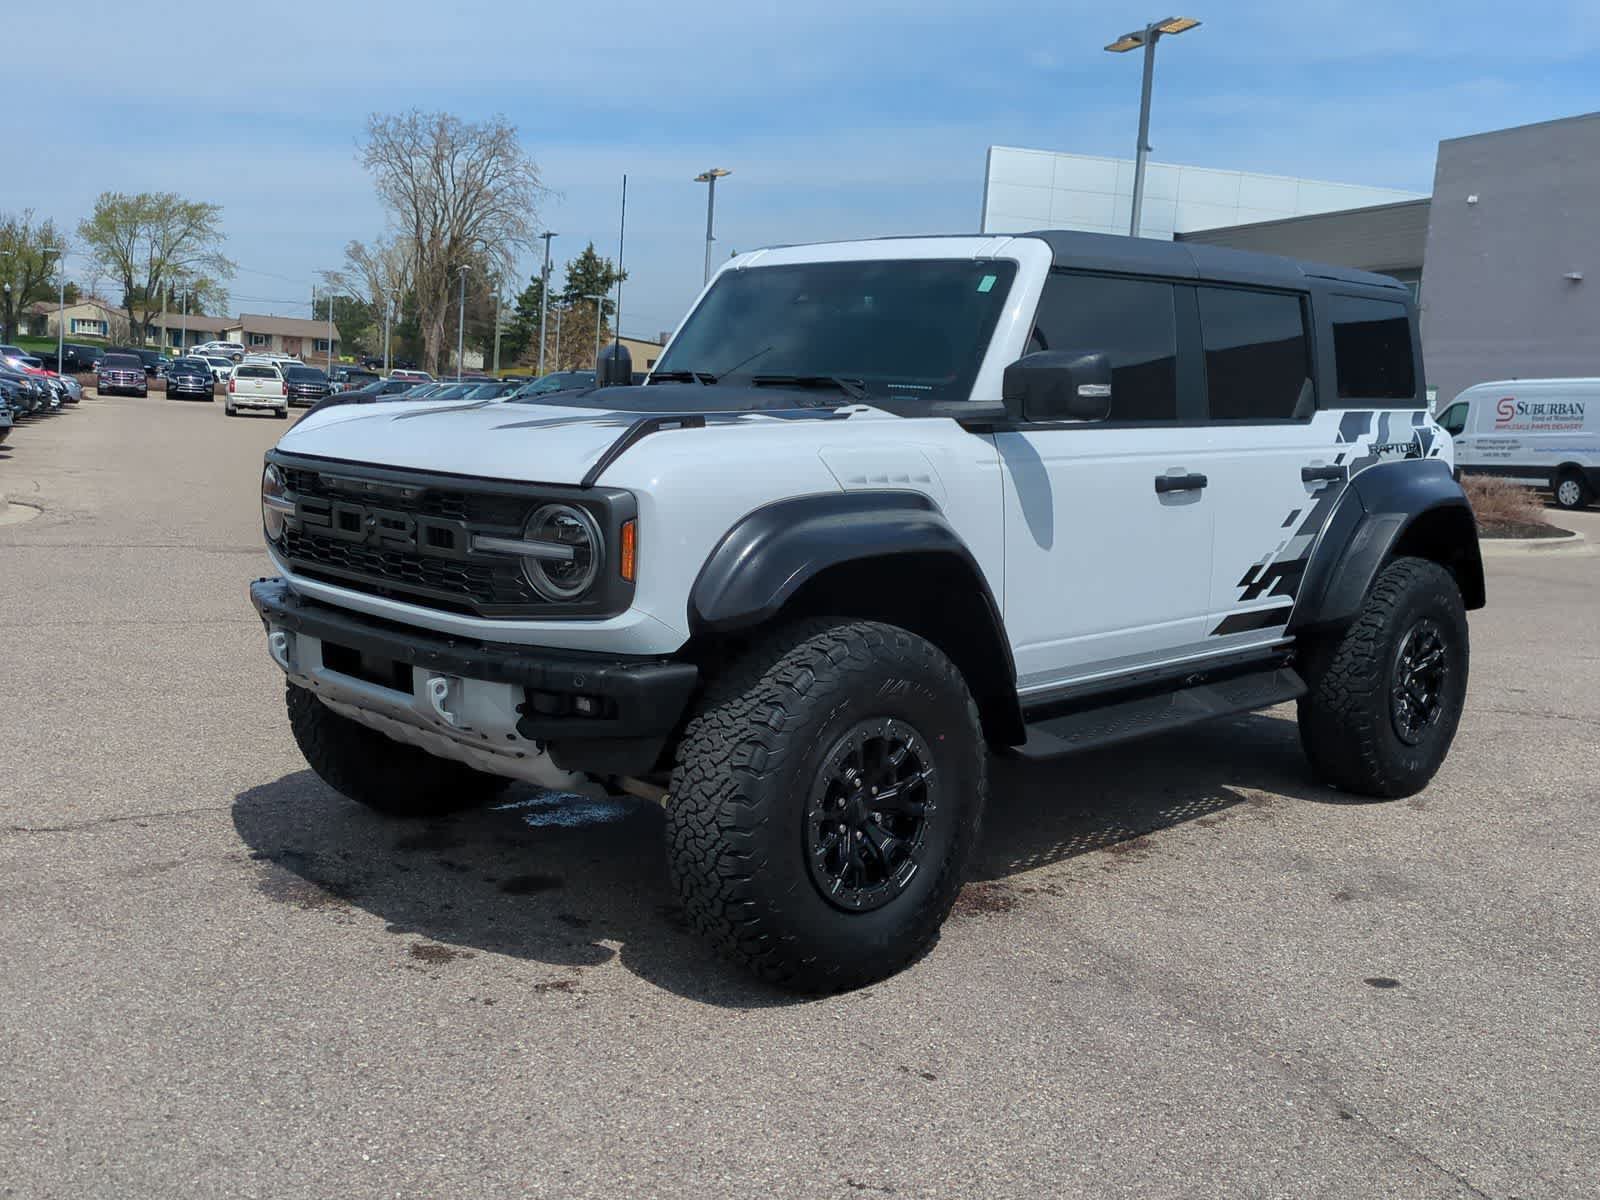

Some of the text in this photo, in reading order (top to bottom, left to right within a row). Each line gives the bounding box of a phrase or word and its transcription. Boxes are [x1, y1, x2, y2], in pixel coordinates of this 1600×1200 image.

[1516, 401, 1585, 416] SUBURBAN
[1368, 442, 1416, 456] RAPTOR
[295, 495, 469, 560] FORD
